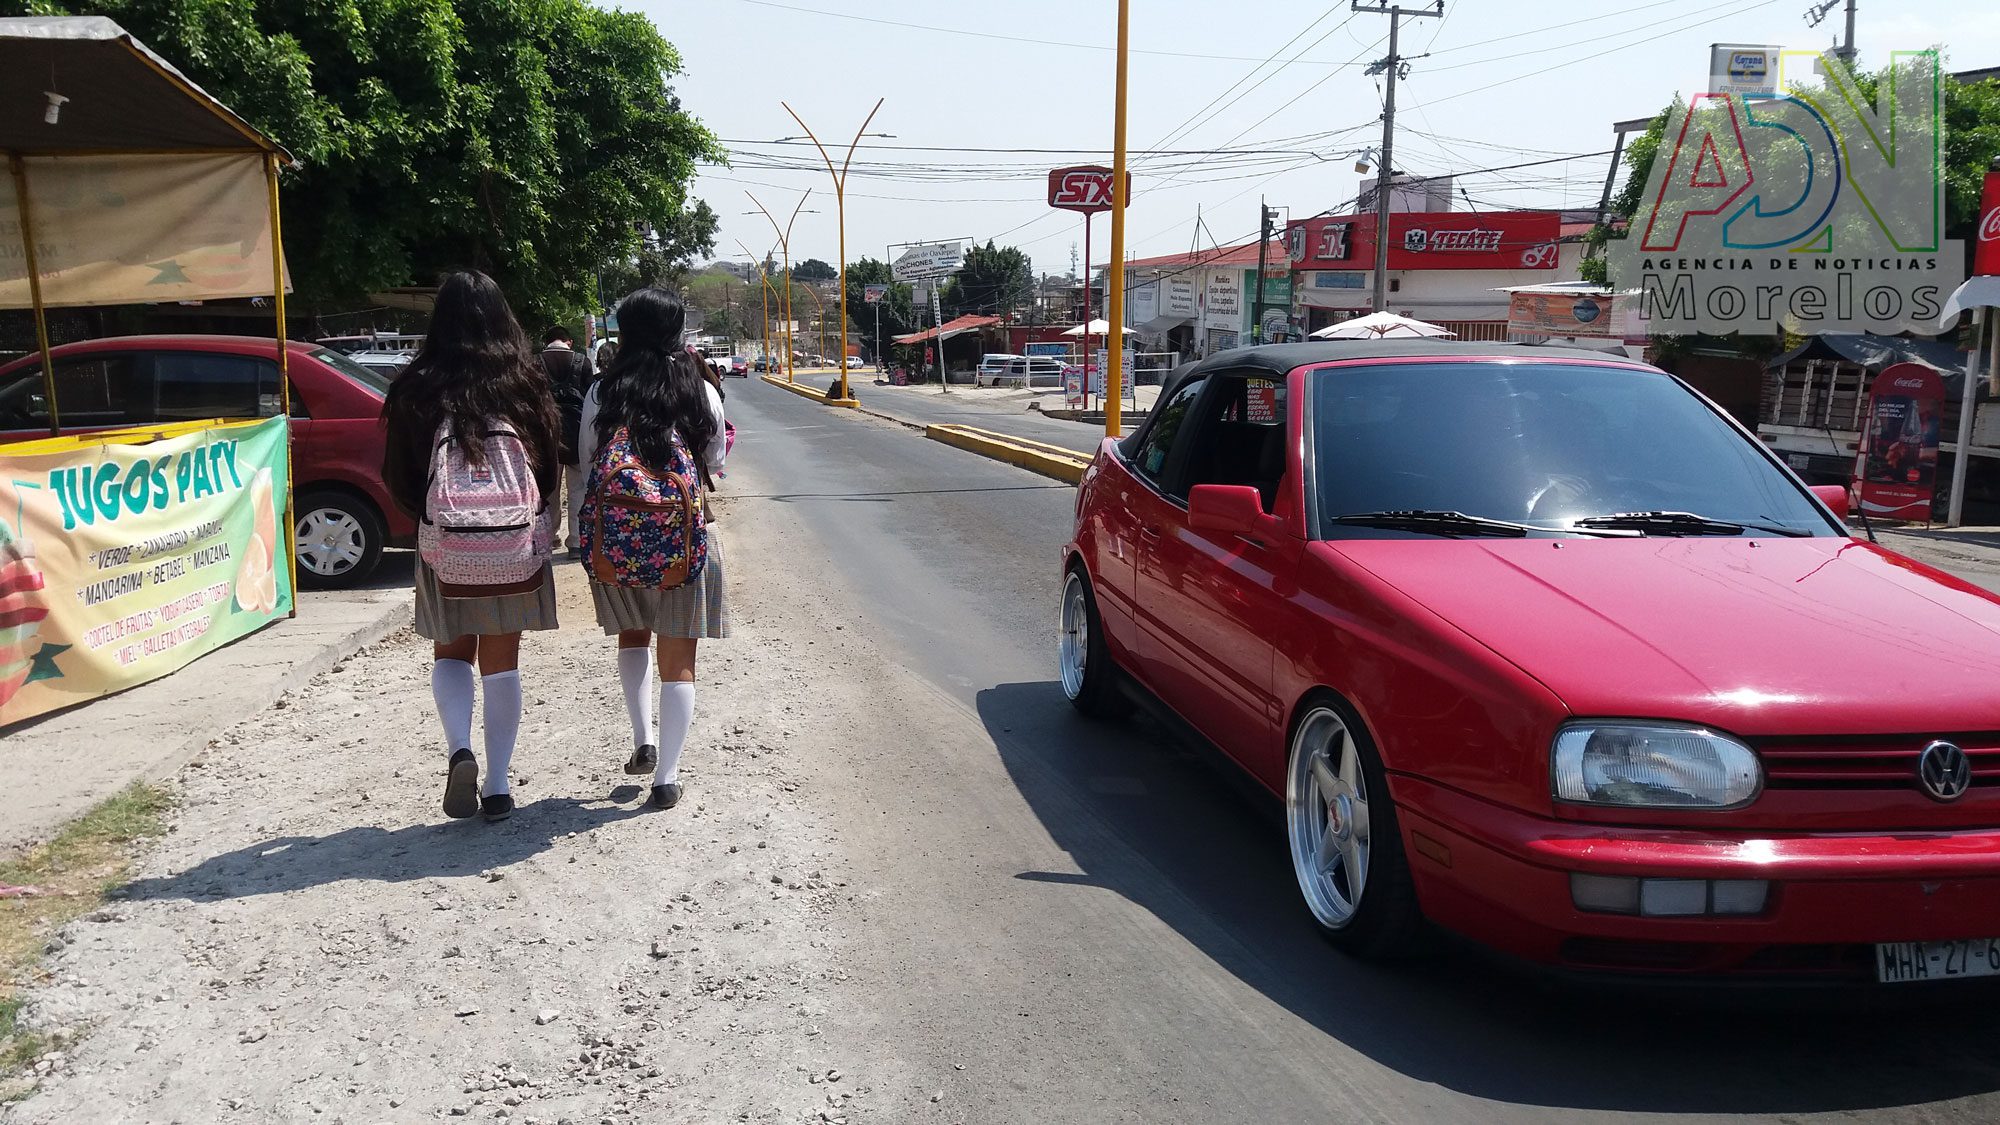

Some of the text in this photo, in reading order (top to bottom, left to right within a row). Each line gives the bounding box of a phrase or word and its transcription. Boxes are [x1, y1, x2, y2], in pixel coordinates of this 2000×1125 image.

[1734, 55, 1763, 65] Corona
[1430, 228, 1504, 252] TECATE
[895, 258, 934, 274] COLCHONES
[49, 440, 243, 531] JUGOS PATY
[98, 545, 134, 569] VERDE
[140, 530, 189, 559] ZANAHORIA
[85, 542, 231, 606] MANDARINA BETABEL MANZANA
[88, 623, 115, 649] COCTEL
[115, 619, 125, 638] DE
[126, 610, 154, 634] FRUTAS
[119, 644, 137, 665] MIEL
[143, 628, 177, 656] GALLETAS
